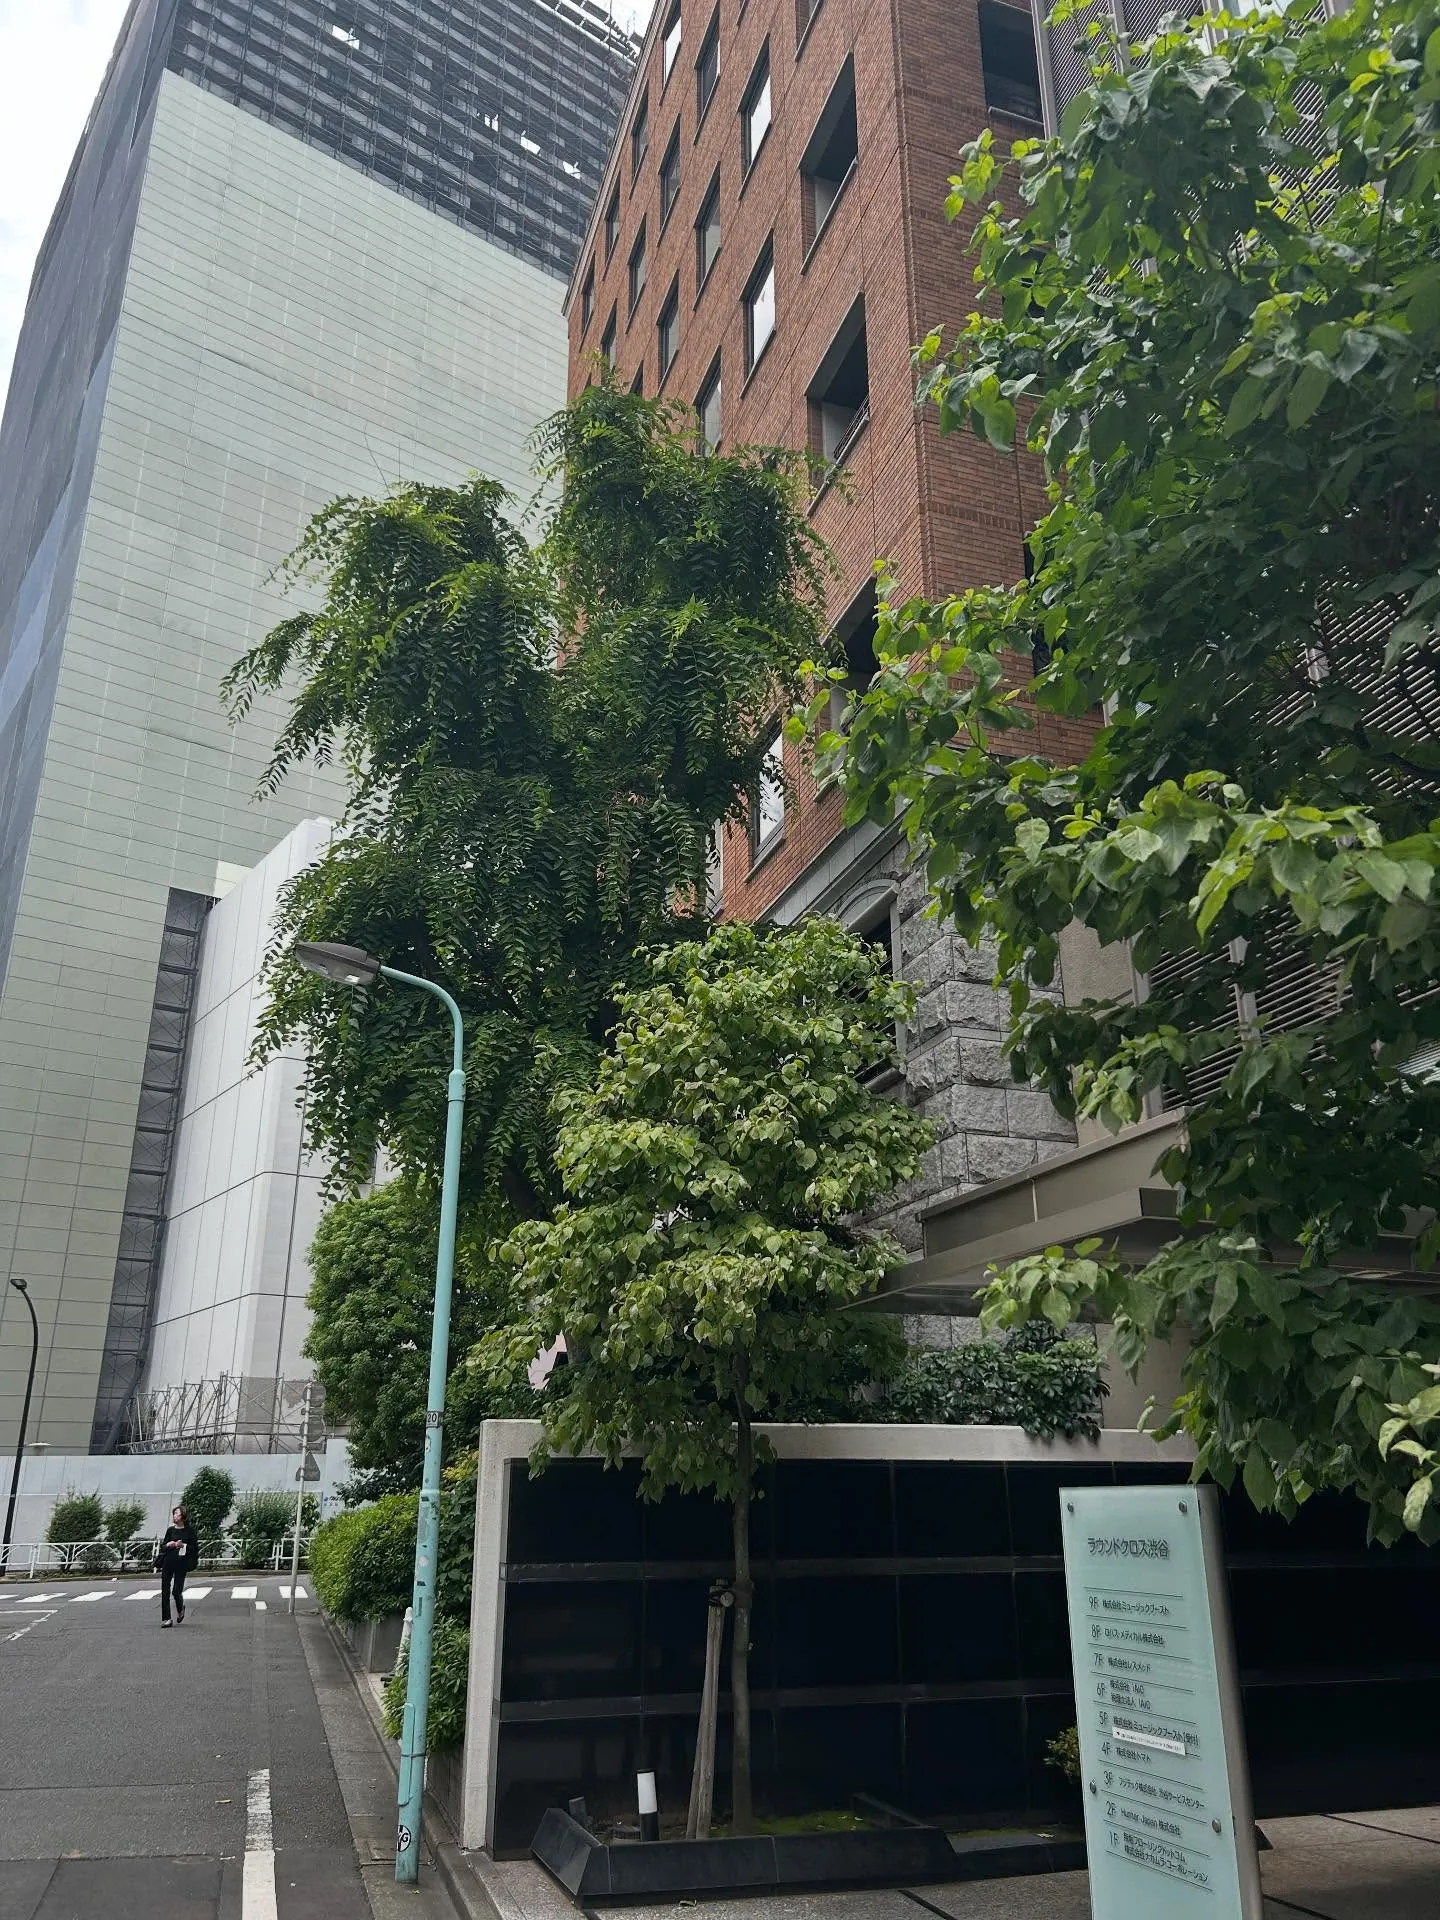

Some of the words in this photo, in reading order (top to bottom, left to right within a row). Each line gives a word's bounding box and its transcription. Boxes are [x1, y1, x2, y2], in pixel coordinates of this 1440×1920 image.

[427, 1412, 437, 1423] 20
[1087, 1537, 1168, 1558] ラウンドクロス渋谷
[1089, 1597, 1098, 1609] 9F
[1092, 1624, 1101, 1638] 8F
[1094, 1653, 1104, 1667] 7F
[1097, 1683, 1105, 1696] 6F
[1099, 1711, 1107, 1725] 5F
[1101, 1742, 1110, 1756] 4F
[1103, 1770, 1113, 1786] 3F
[1106, 1800, 1116, 1816] 2F
[1158, 1820, 1181, 1837] 株式会社
[1109, 1831, 1118, 1847] 1F
